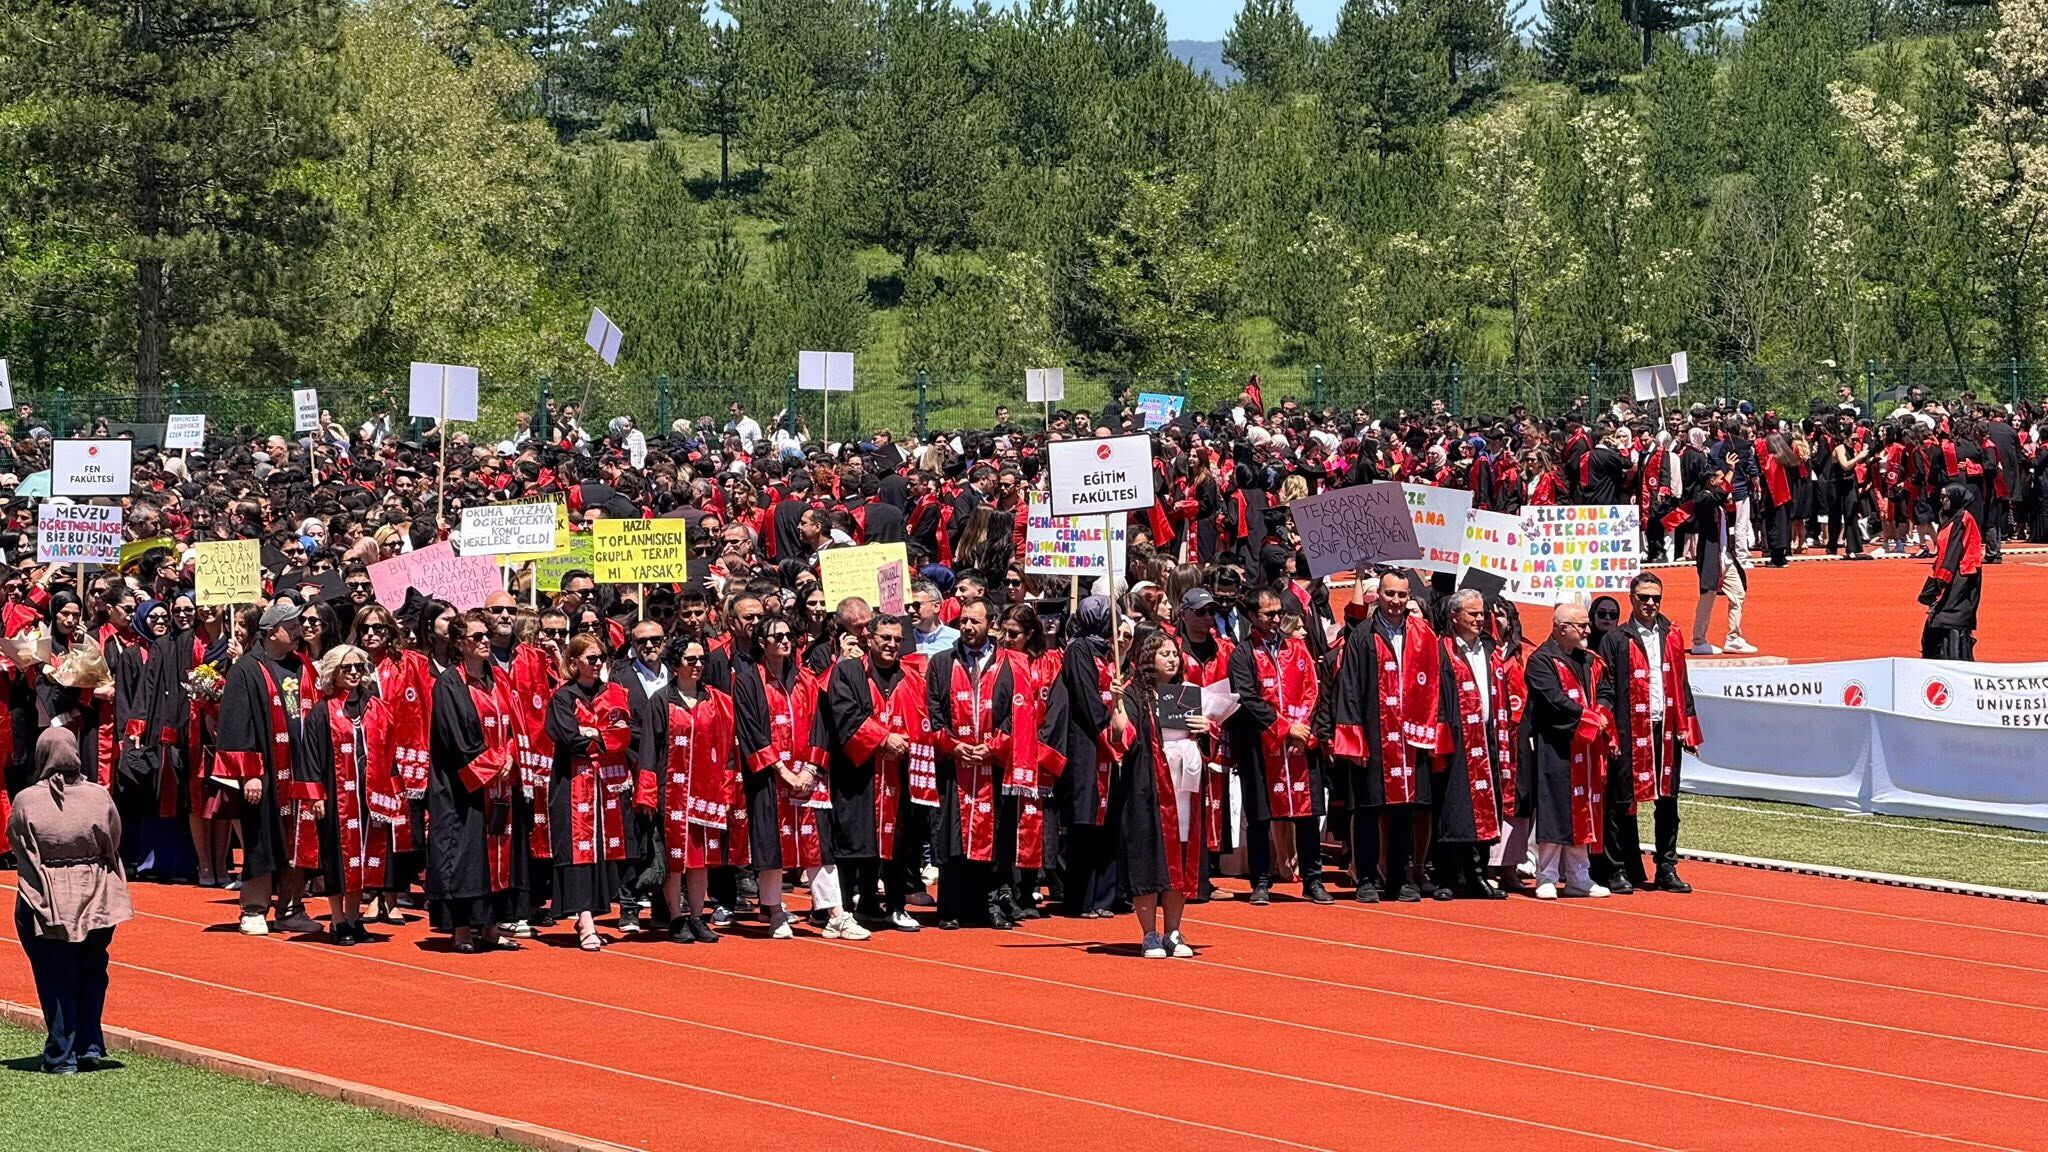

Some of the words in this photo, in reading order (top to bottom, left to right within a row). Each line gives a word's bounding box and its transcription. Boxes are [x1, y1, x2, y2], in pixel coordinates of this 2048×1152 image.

[84, 465, 101, 473] FEN
[70, 472, 114, 483] FAKÜLTESİ
[1083, 470, 1126, 486] EĞİTİM
[1072, 485, 1138, 505] FAKÜLTESİ
[465, 506, 504, 518] OKUMA
[510, 504, 553, 516] YAZMA
[1299, 490, 1391, 519] TEKRARDAN
[56, 506, 110, 521] MEVZU
[1537, 506, 1620, 522] İLKOKULA
[491, 526, 521, 537] KONU
[622, 519, 652, 532] HAZIR
[1307, 515, 1401, 545] OLAMAYINCA
[1542, 522, 1609, 537] TEKRAR
[67, 531, 84, 543] BU
[1465, 525, 1499, 543] OKUL
[40, 543, 121, 558] VAKKOSUYUZ
[214, 542, 234, 554] BEN
[238, 541, 250, 553] BU
[1308, 540, 1341, 559] SINIF
[1339, 543, 1389, 565] OLDUK
[199, 552, 253, 565] OKULDAN
[595, 549, 634, 562] GRUPLA
[387, 558, 407, 576] BU
[481, 565, 498, 577] DA
[631, 563, 683, 580] YAPSAK?
[1522, 559, 1557, 573] AMA
[1562, 558, 1583, 572] BU
[214, 574, 250, 587] ALDIM
[431, 584, 457, 599] SON
[1723, 681, 1823, 698] KASTAMONU
